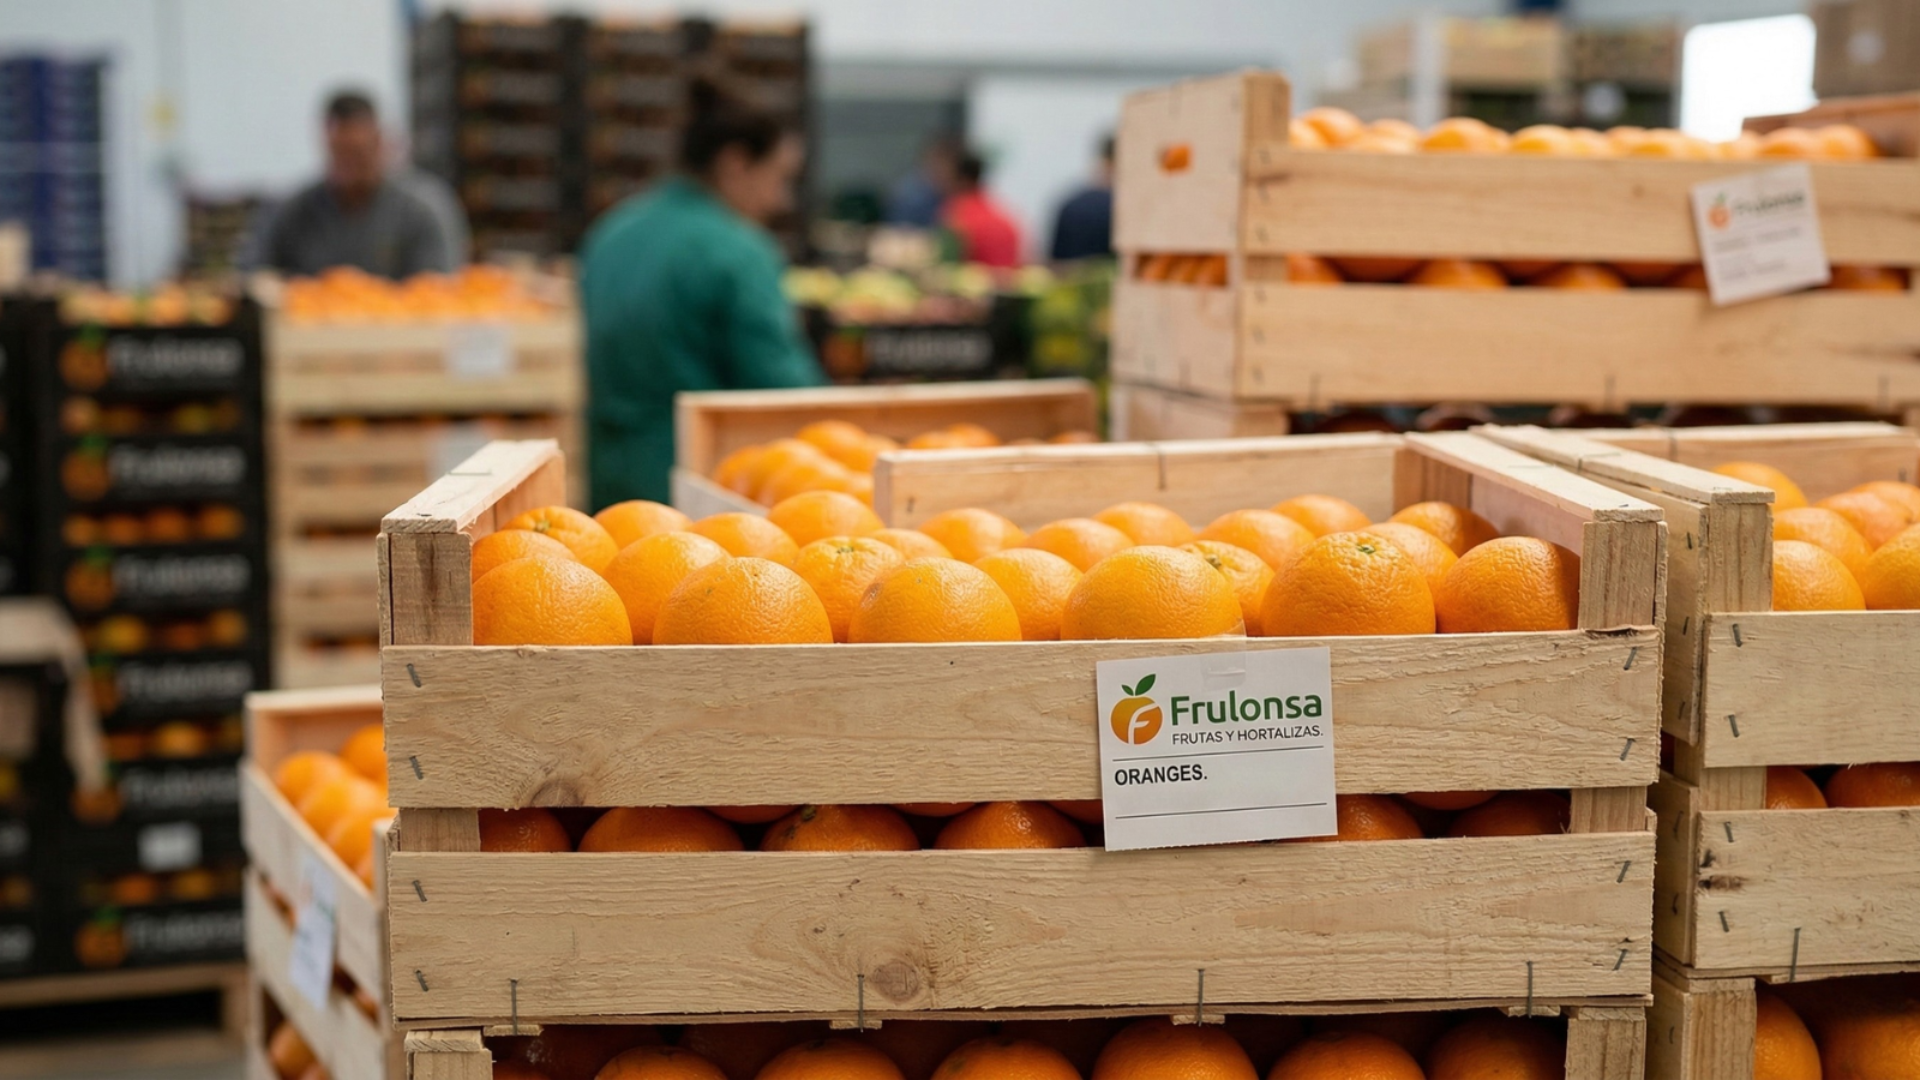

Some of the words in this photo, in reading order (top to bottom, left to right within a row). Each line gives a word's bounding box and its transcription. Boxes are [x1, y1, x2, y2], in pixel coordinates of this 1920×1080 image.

[1171, 690, 1323, 726] Frulonsa
[1173, 731, 1223, 744] FRUTAS
[1226, 731, 1234, 741] Y
[1238, 725, 1323, 740] HORTALIZAS.
[1115, 764, 1208, 785] ORANGES.
